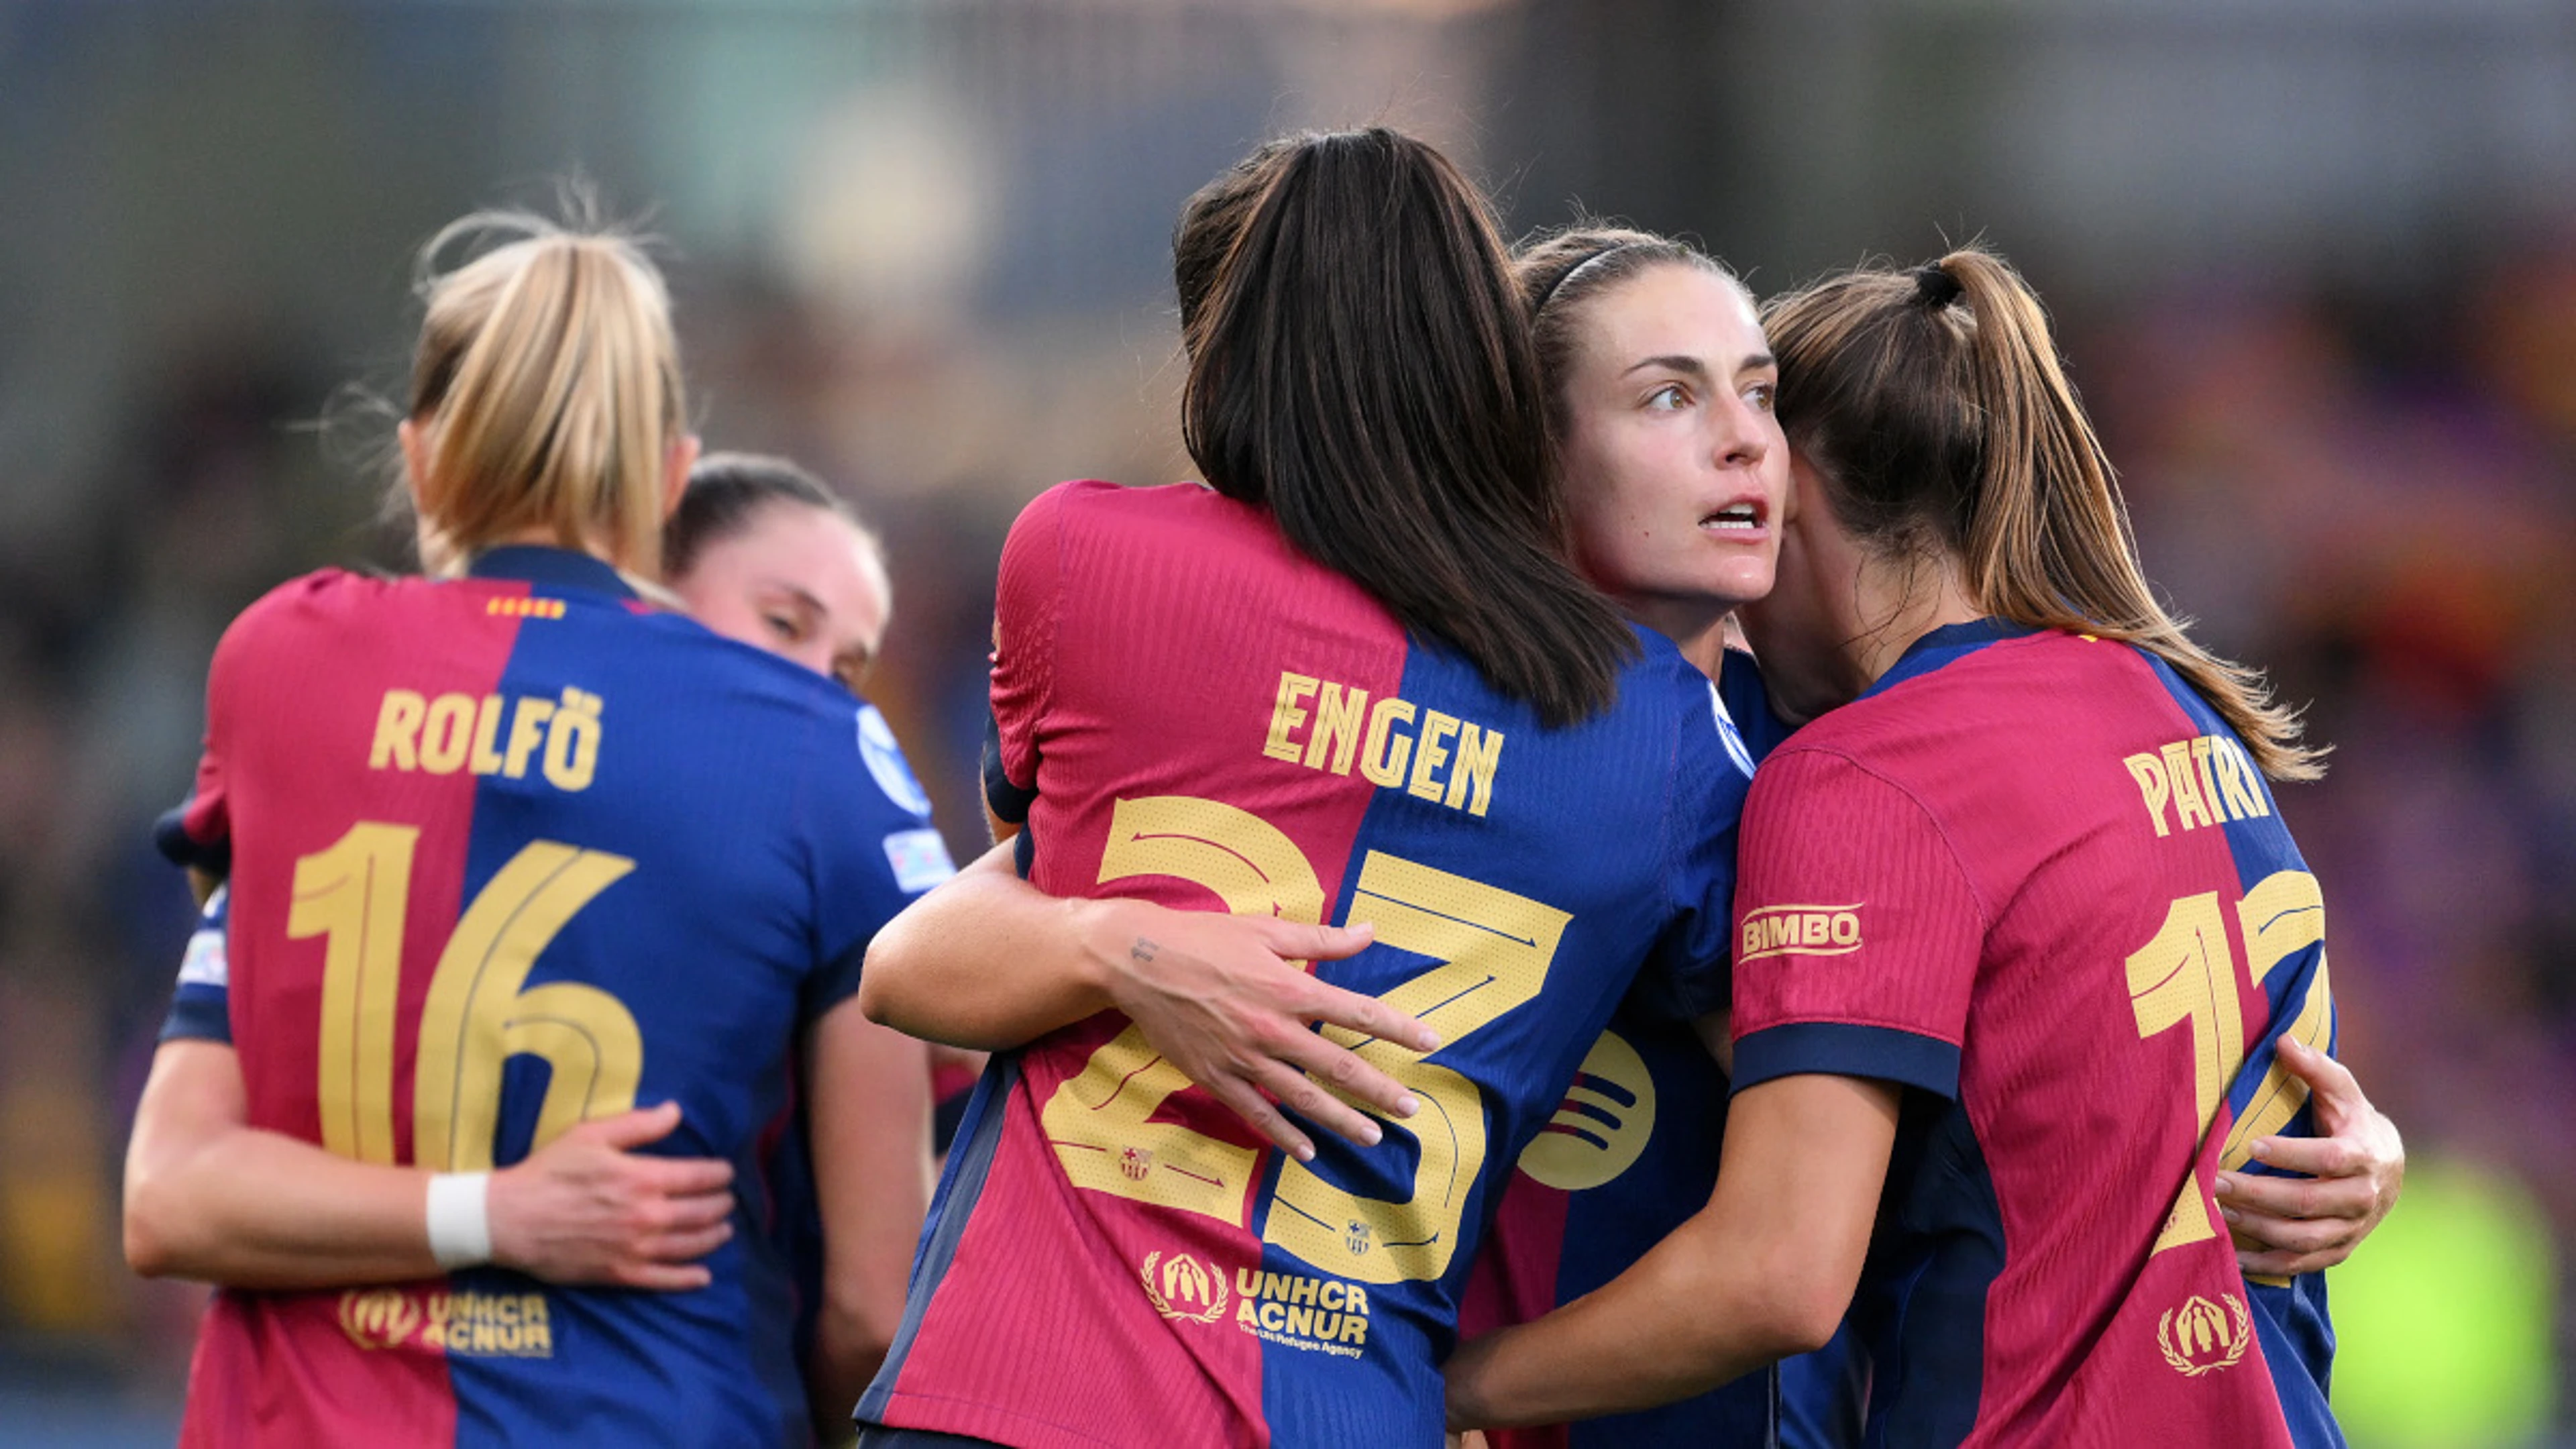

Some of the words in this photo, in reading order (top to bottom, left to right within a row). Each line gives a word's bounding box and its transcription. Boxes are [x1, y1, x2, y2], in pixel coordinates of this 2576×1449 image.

[368, 686, 603, 792] ROLFÖ
[1263, 672, 1503, 816] ENGEN
[2123, 735, 2270, 838] PATRI
[1743, 912, 1860, 954] BIMBO
[286, 821, 643, 1175] 16
[1041, 796, 1574, 1283] 23
[2125, 869, 2331, 1289] 12
[421, 1320, 553, 1352] ACNUR
[1236, 1268, 1369, 1315] UNHCR
[1236, 1298, 1368, 1344] ACNUR
[1277, 1333, 1320, 1351] Refugee
[1322, 1341, 1363, 1360] Agency
